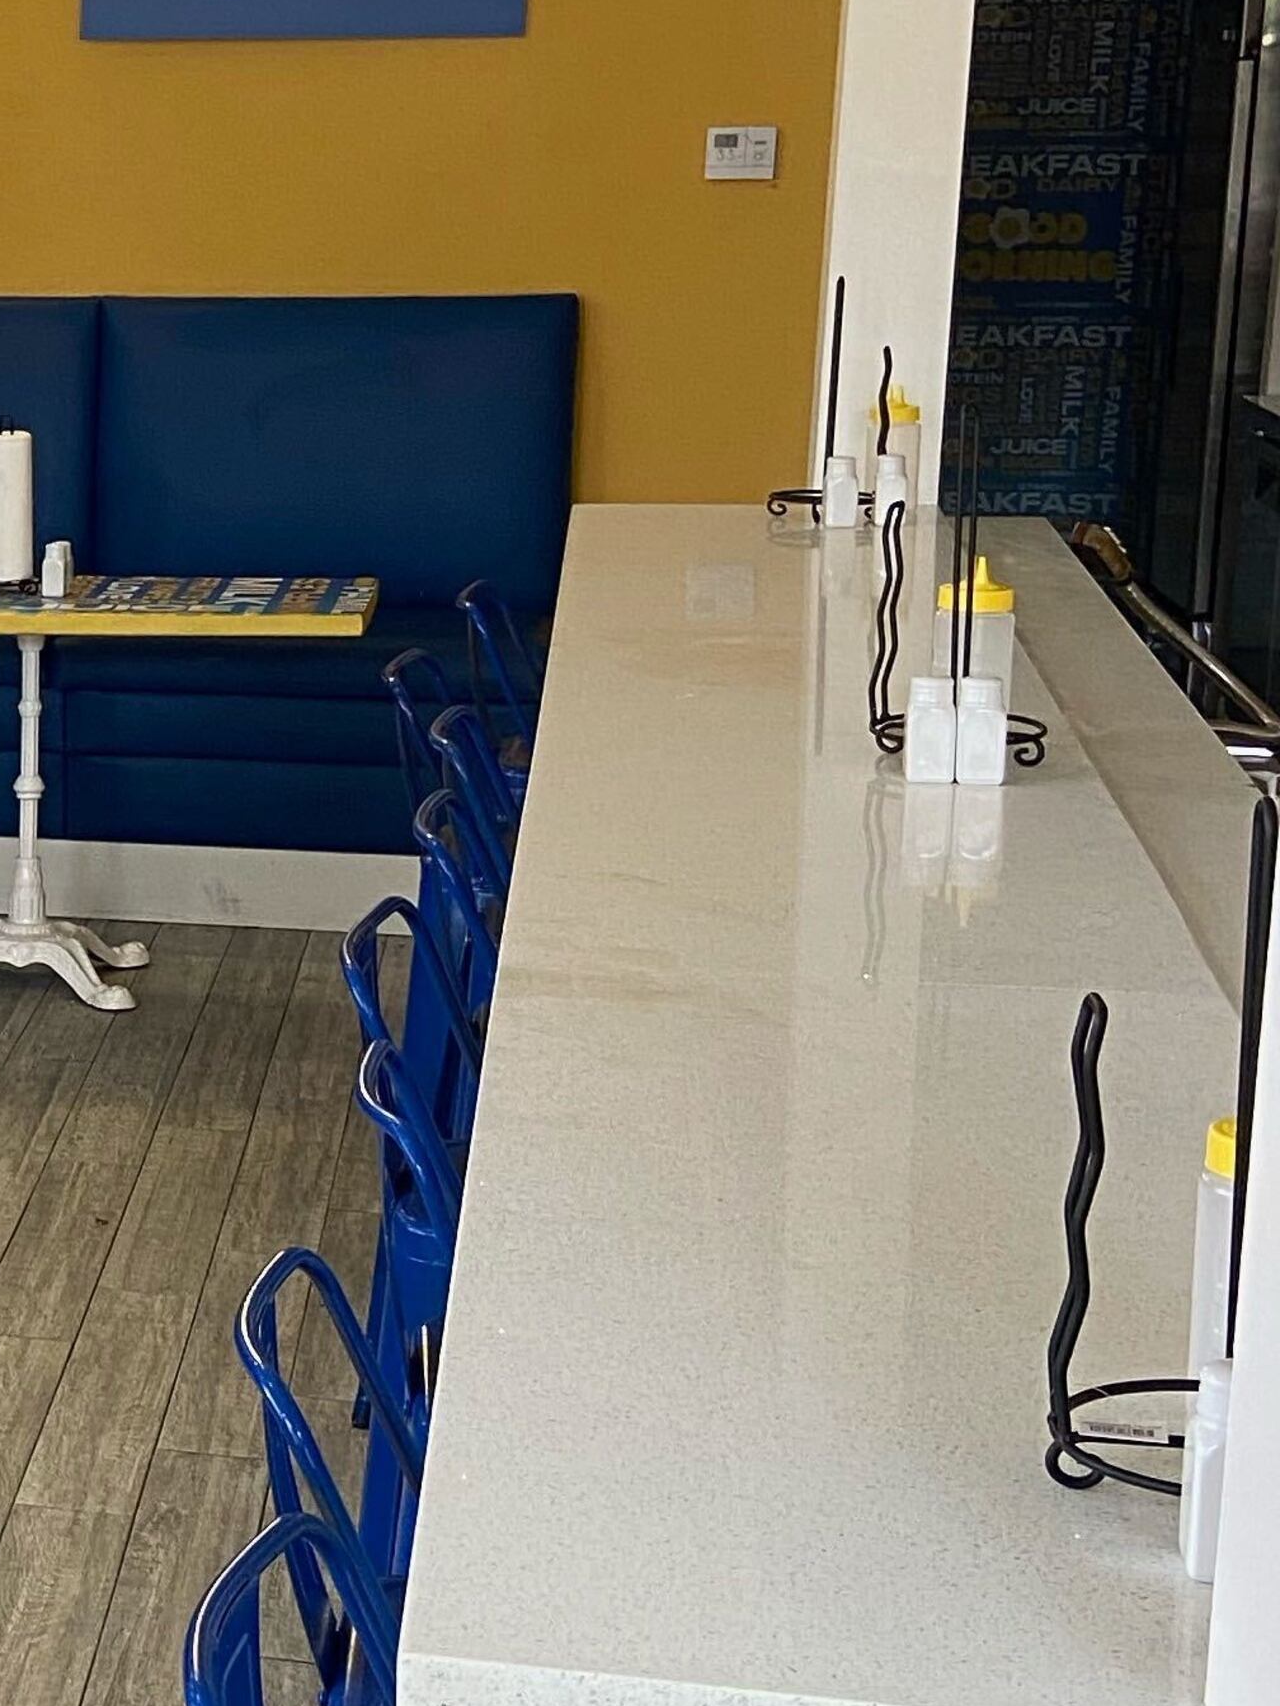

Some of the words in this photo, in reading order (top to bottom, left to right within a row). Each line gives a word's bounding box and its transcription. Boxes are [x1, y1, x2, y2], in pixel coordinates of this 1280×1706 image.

[1089, 20, 1115, 95] MILK
[1125, 40, 1152, 133] FAMILY
[1016, 96, 1099, 116] JUICE
[971, 152, 1147, 177] EAKFAST
[960, 249, 1117, 282] ORNING
[1115, 214, 1138, 305] FAMILY
[956, 324, 1132, 348] EAKFAST
[1061, 365, 1088, 437] MILK
[1097, 385, 1122, 474] FAMILY
[989, 439, 1069, 456] JUICE
[944, 492, 1120, 515] EAKFAST
